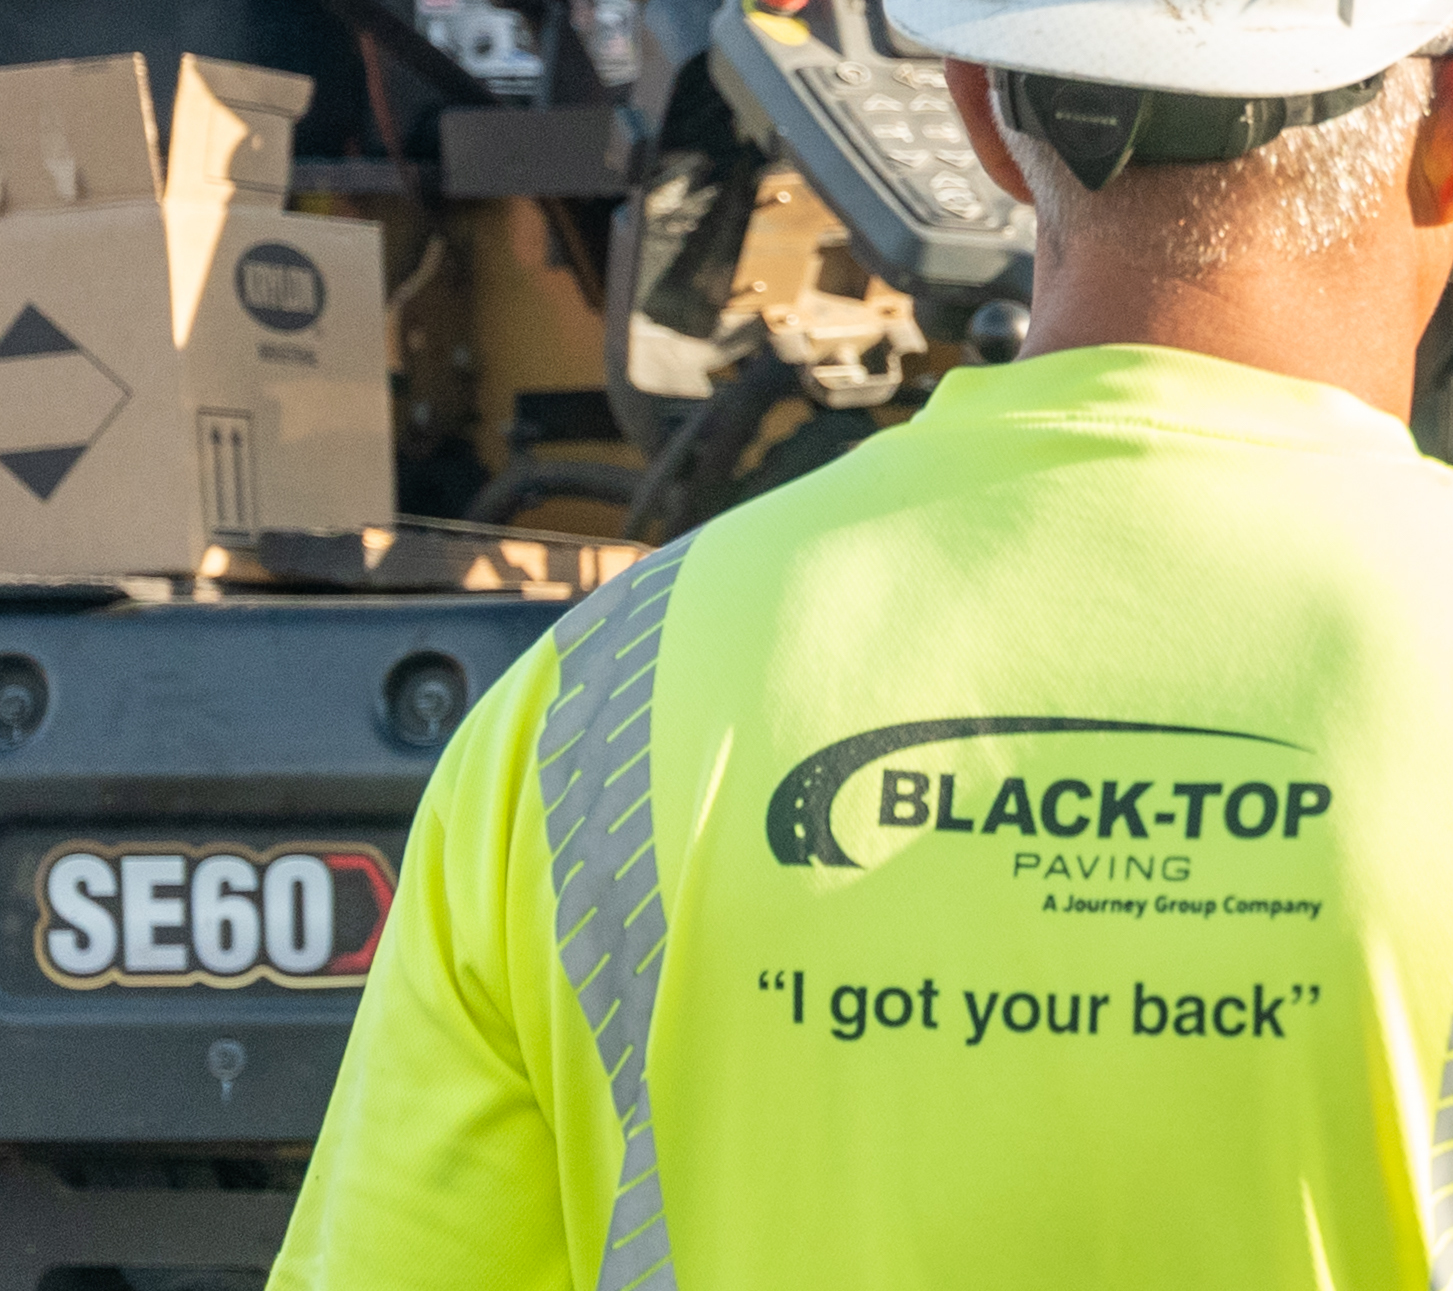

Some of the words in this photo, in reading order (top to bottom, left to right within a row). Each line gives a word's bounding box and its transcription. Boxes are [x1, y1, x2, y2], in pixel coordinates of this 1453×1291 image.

[879, 770, 1332, 839] BLACK-TOP
[1014, 853, 1191, 881] PAVING
[47, 853, 334, 974] SE60
[1043, 895, 1057, 912] A
[1063, 895, 1148, 918] Journey
[1155, 895, 1217, 917] Group
[1223, 896, 1322, 919] Company
[830, 978, 940, 1041] got
[963, 989, 1110, 1046] your
